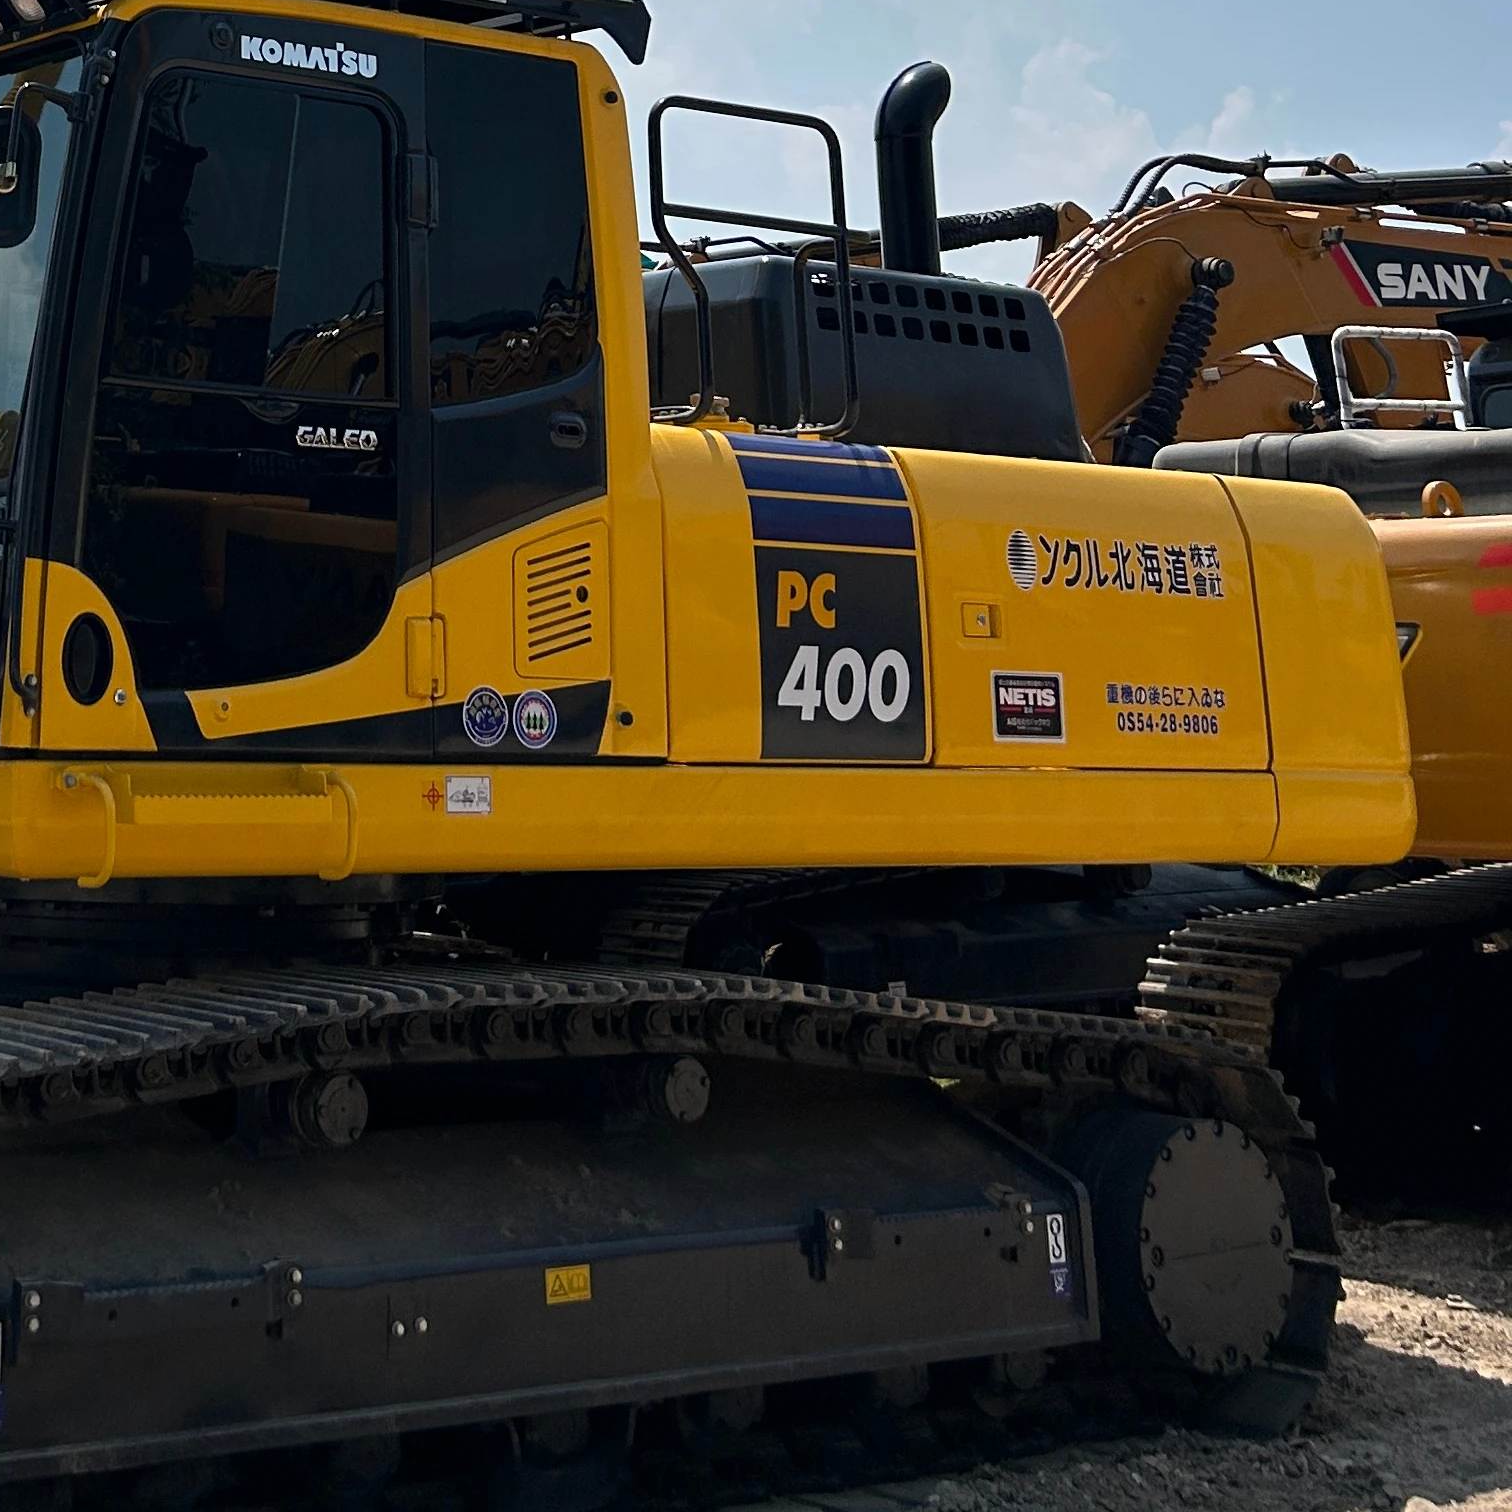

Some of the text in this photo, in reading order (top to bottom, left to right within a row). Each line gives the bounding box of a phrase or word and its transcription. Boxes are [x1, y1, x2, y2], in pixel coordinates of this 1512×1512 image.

[240, 34, 378, 78] KOMATSU
[1376, 262, 1491, 301] SANY
[295, 425, 379, 450] GALEO
[776, 570, 836, 629] PC
[777, 645, 911, 722] 400
[998, 686, 1056, 707] NETIS
